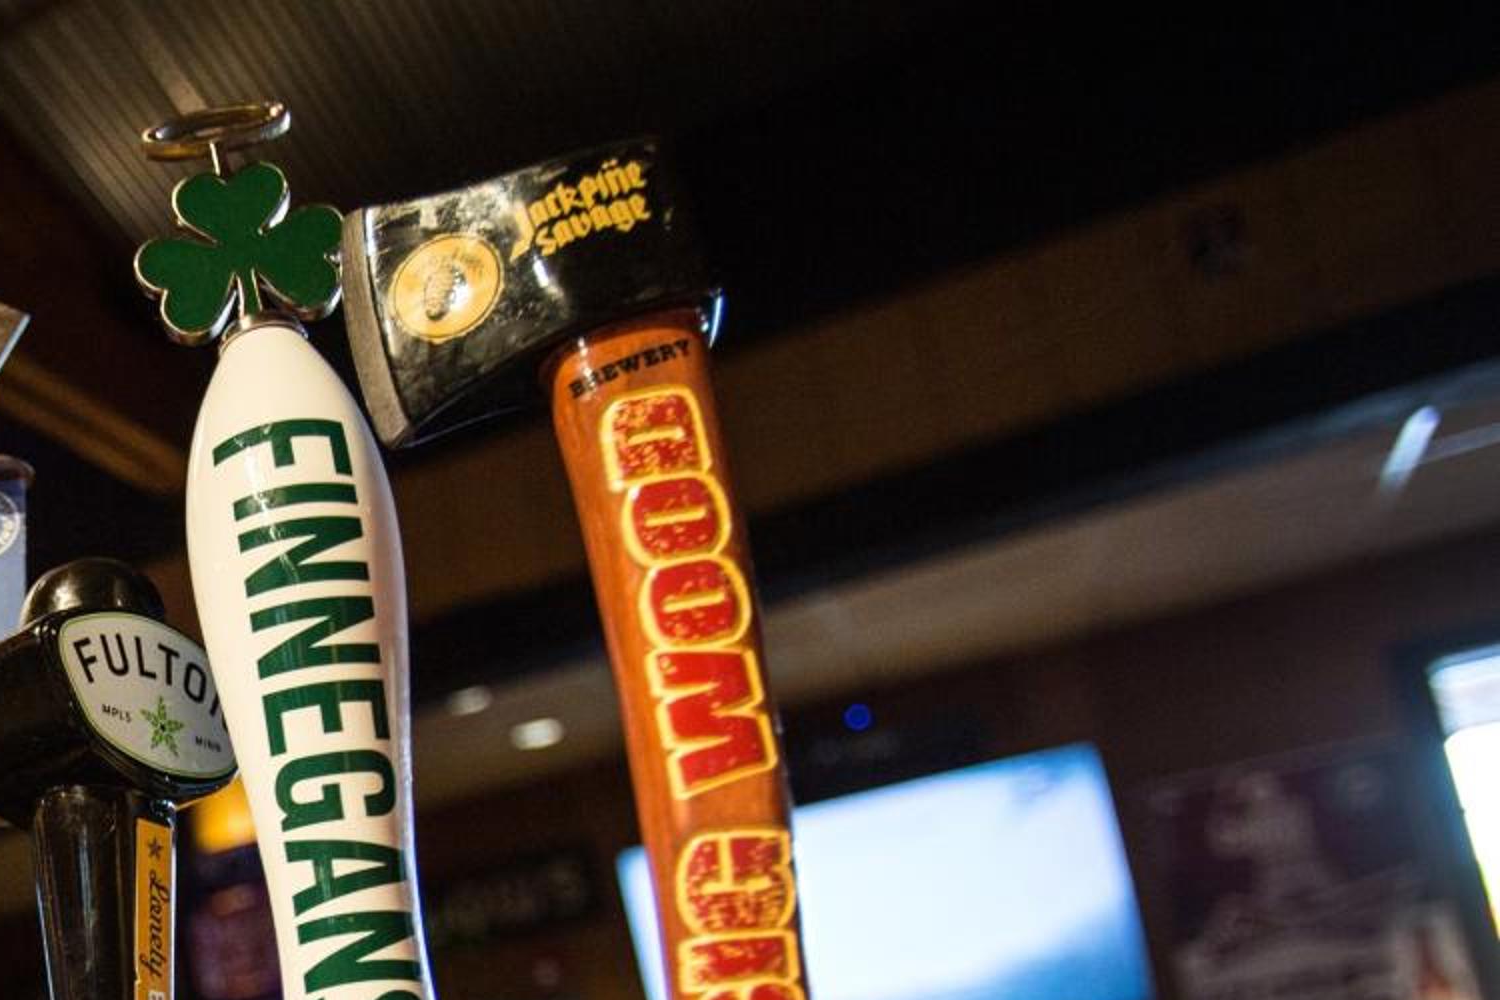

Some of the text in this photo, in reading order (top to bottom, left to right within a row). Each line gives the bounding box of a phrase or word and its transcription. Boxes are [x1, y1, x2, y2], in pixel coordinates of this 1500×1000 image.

[535, 194, 650, 257] Savage
[569, 338, 691, 398] BREWERY
[601, 384, 778, 800] WOOD
[101, 703, 132, 724] MPLS
[140, 868, 169, 979] Lonely
